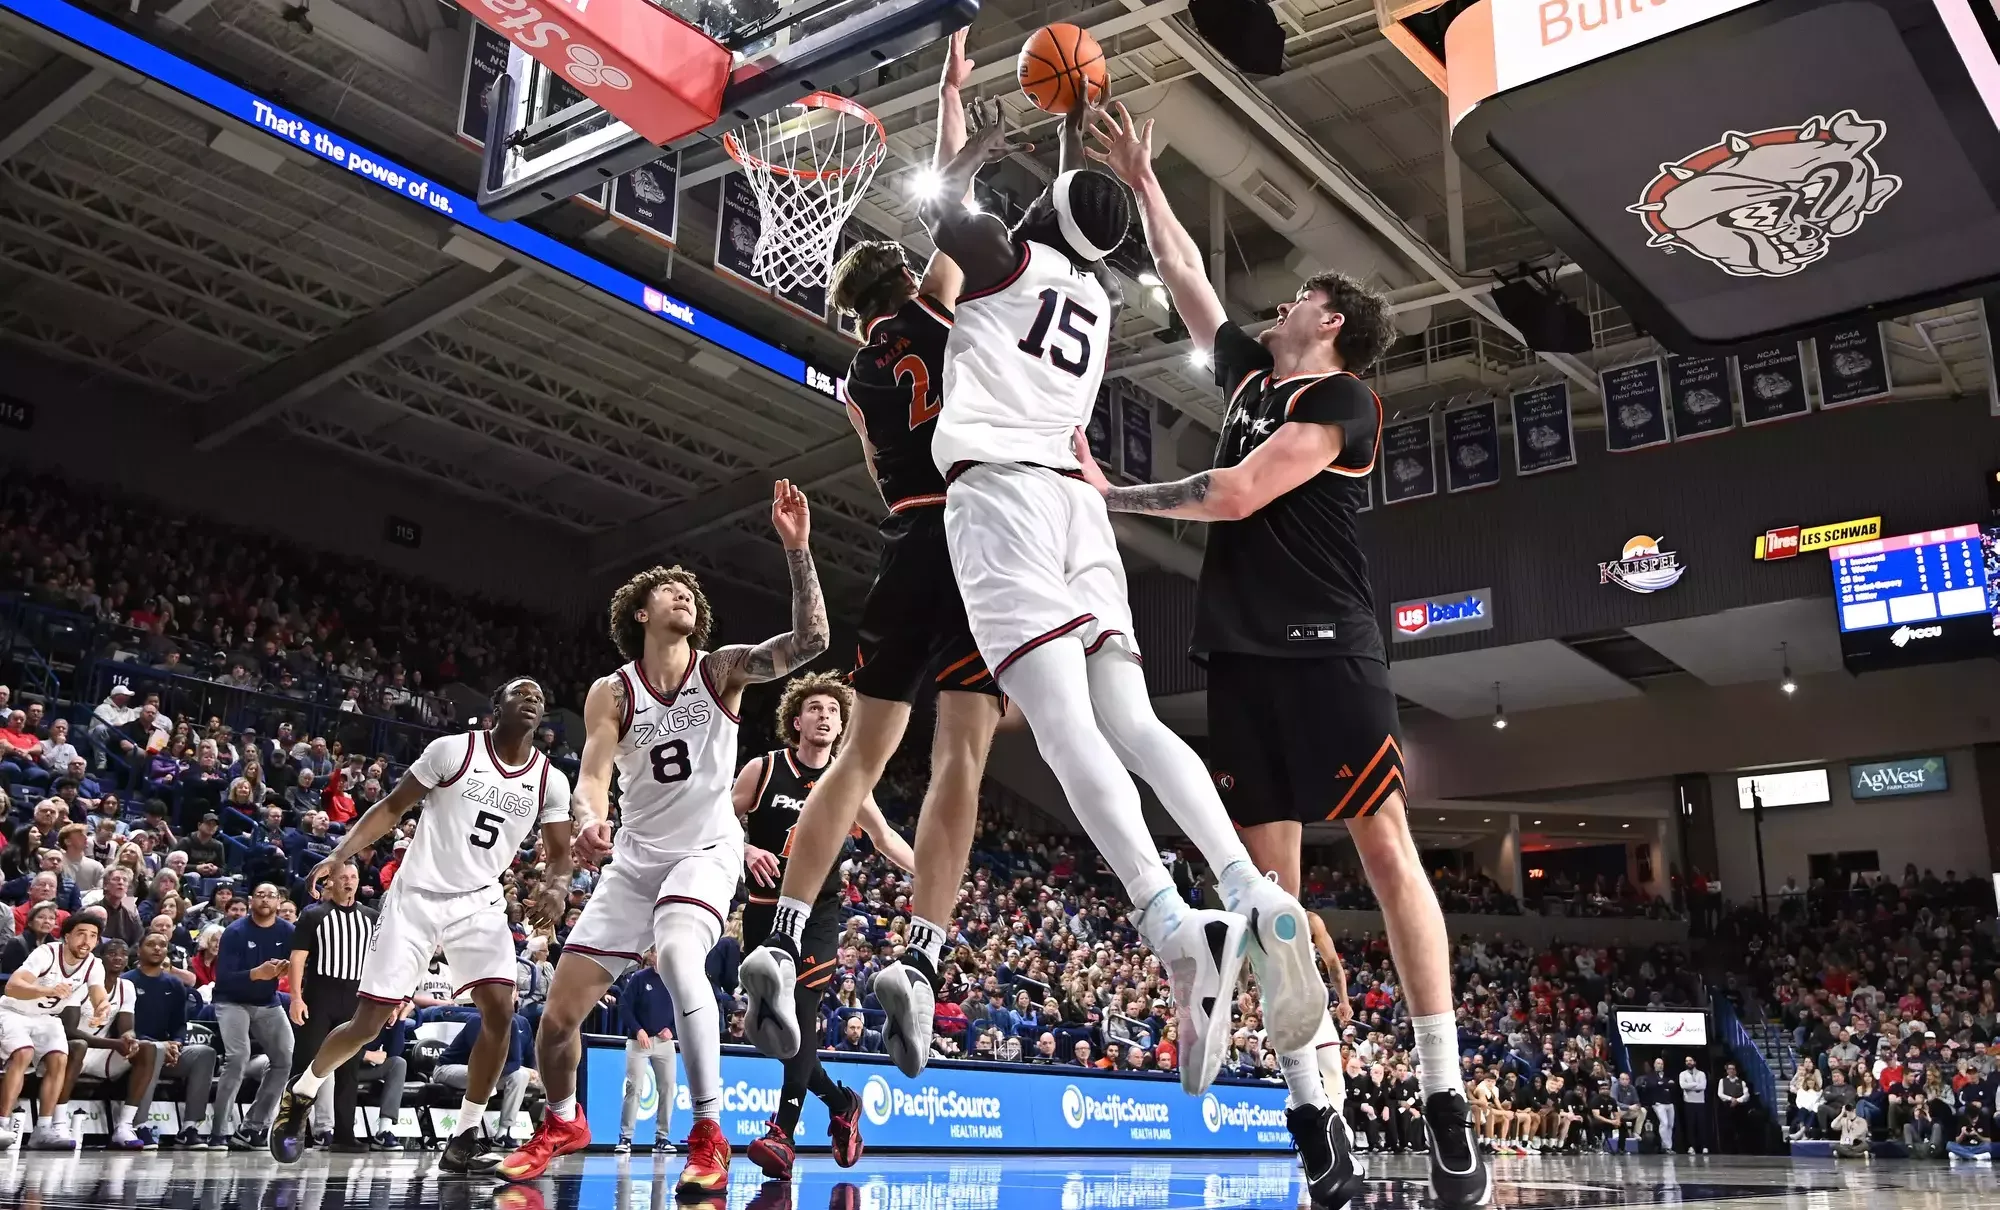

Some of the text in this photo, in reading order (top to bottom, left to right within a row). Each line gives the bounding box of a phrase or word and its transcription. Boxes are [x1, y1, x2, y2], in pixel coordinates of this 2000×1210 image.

[474, 57, 496, 75] West
[253, 100, 453, 214] That's the power of us.
[638, 207, 653, 218] 2000
[663, 296, 695, 325] bank
[1018, 288, 1098, 378] 15
[1835, 330, 1860, 341] NCAA
[1756, 348, 1780, 359] NCAA
[1686, 365, 1709, 375] NCAA
[1743, 354, 1797, 371] Sweet Sixteen
[1620, 381, 1643, 392] NCAA
[1531, 404, 1552, 413] NCAA
[397, 525, 415, 540] 115
[1766, 523, 1877, 553] Tires LES SCHWAB
[1597, 554, 1680, 584] KALISPEL
[1399, 595, 1482, 627] us bank
[112, 674, 130, 687] 114
[634, 700, 710, 749] ZAGS
[649, 738, 692, 784] 8
[1857, 767, 1926, 792] AgWest
[462, 778, 533, 817] ZAGS
[470, 810, 506, 850] 5
[1620, 1020, 1652, 1033] SWX
[184, 1033, 213, 1044] ADY
[892, 1085, 1001, 1126] PacificSource
[1085, 1094, 1169, 1128] PacificSource
[148, 1113, 170, 1122] CCU
[736, 1119, 771, 1136] HEALT
[950, 1124, 1003, 1139] HEALTH PLANS
[1131, 1127, 1171, 1140] HEALTH PLANS
[1257, 1131, 1274, 1143] HEALTH
